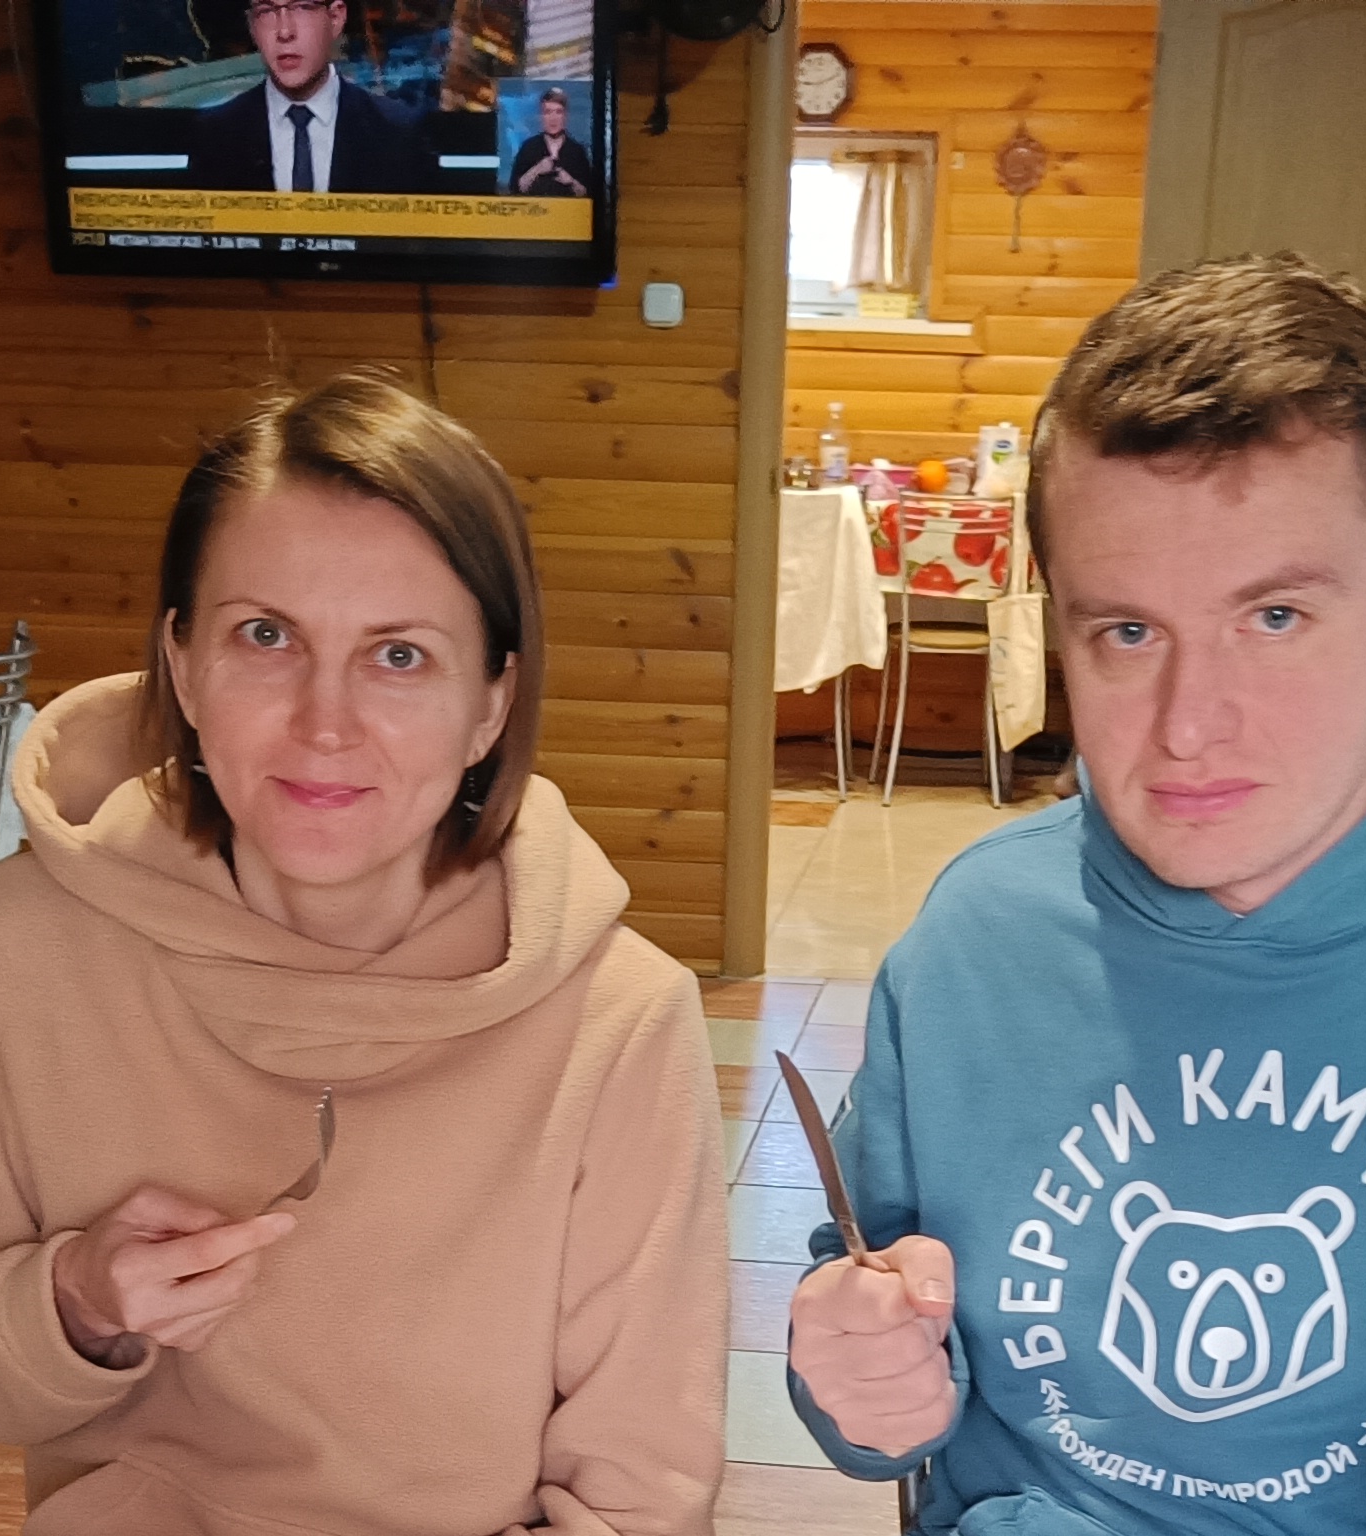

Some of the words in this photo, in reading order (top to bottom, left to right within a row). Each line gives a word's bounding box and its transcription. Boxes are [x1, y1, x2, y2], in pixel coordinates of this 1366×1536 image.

[998, 1083, 1155, 1370] БЕРЕГИ
[1047, 1418, 1167, 1491] РОЖДЕН
[1172, 1441, 1358, 1503] ПРИРОДОЙ
